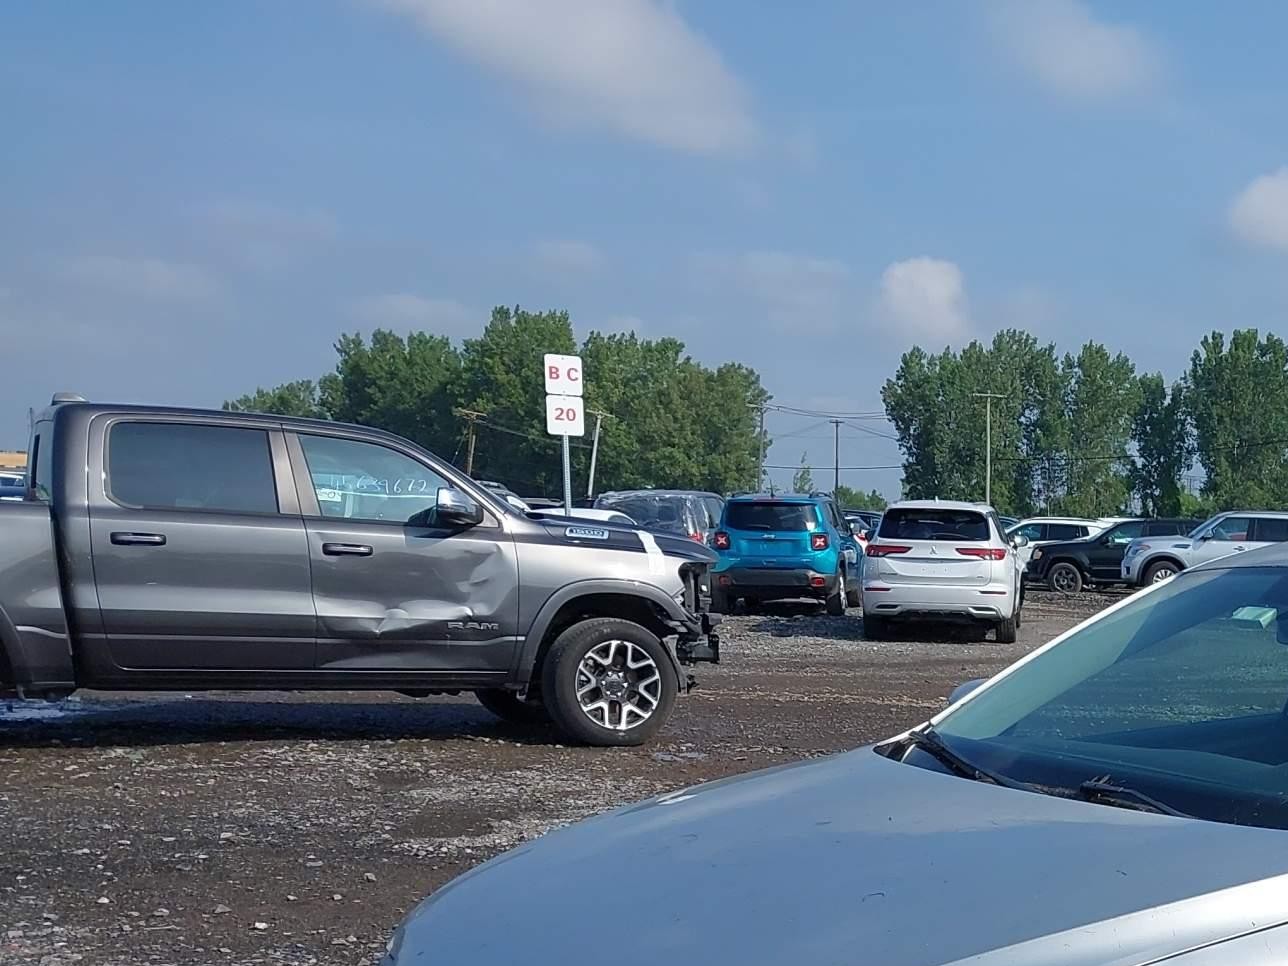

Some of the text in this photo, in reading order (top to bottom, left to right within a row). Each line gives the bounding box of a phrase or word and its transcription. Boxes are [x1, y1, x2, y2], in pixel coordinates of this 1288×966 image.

[548, 366, 579, 382] B C
[554, 407, 576, 421] 20
